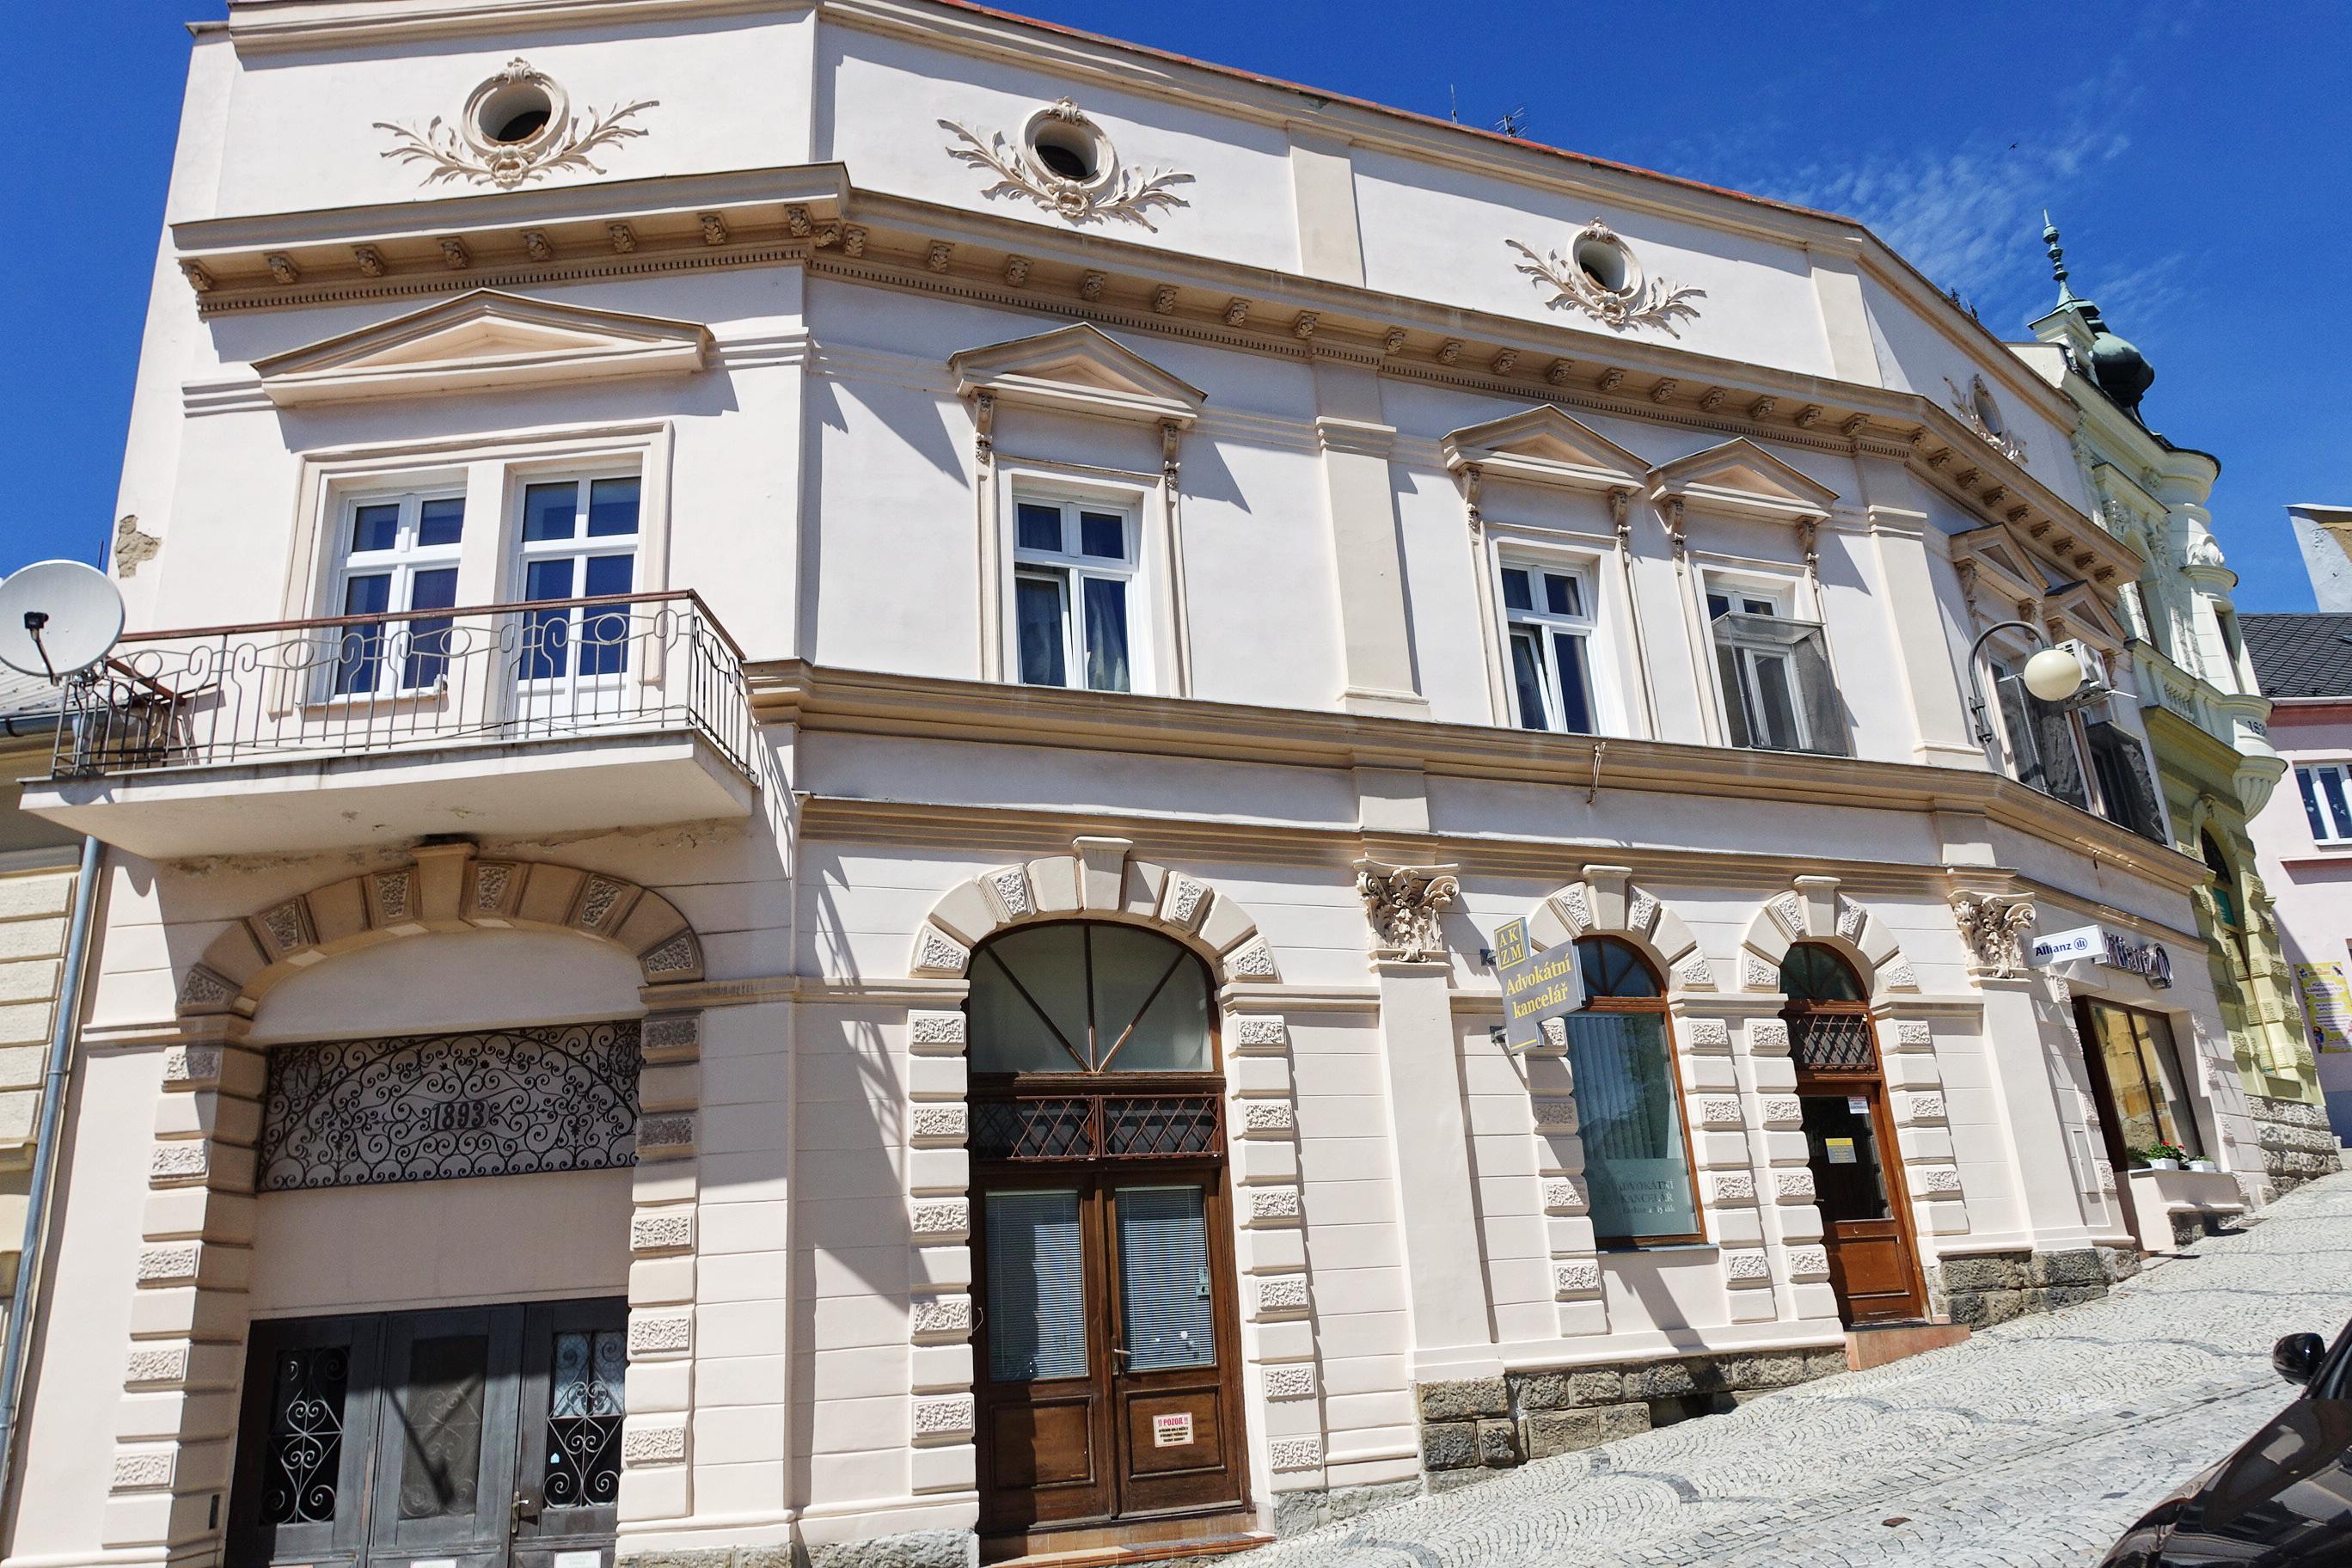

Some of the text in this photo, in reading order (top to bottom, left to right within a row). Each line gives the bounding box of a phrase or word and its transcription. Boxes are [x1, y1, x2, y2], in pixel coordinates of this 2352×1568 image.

[2036, 943, 2072, 956] Allianz
[1505, 952, 1571, 996] Advokátní
[1512, 982, 1569, 1019] kancelář
[432, 1101, 485, 1130] 1893
[1163, 1417, 1183, 1426] POZOR
